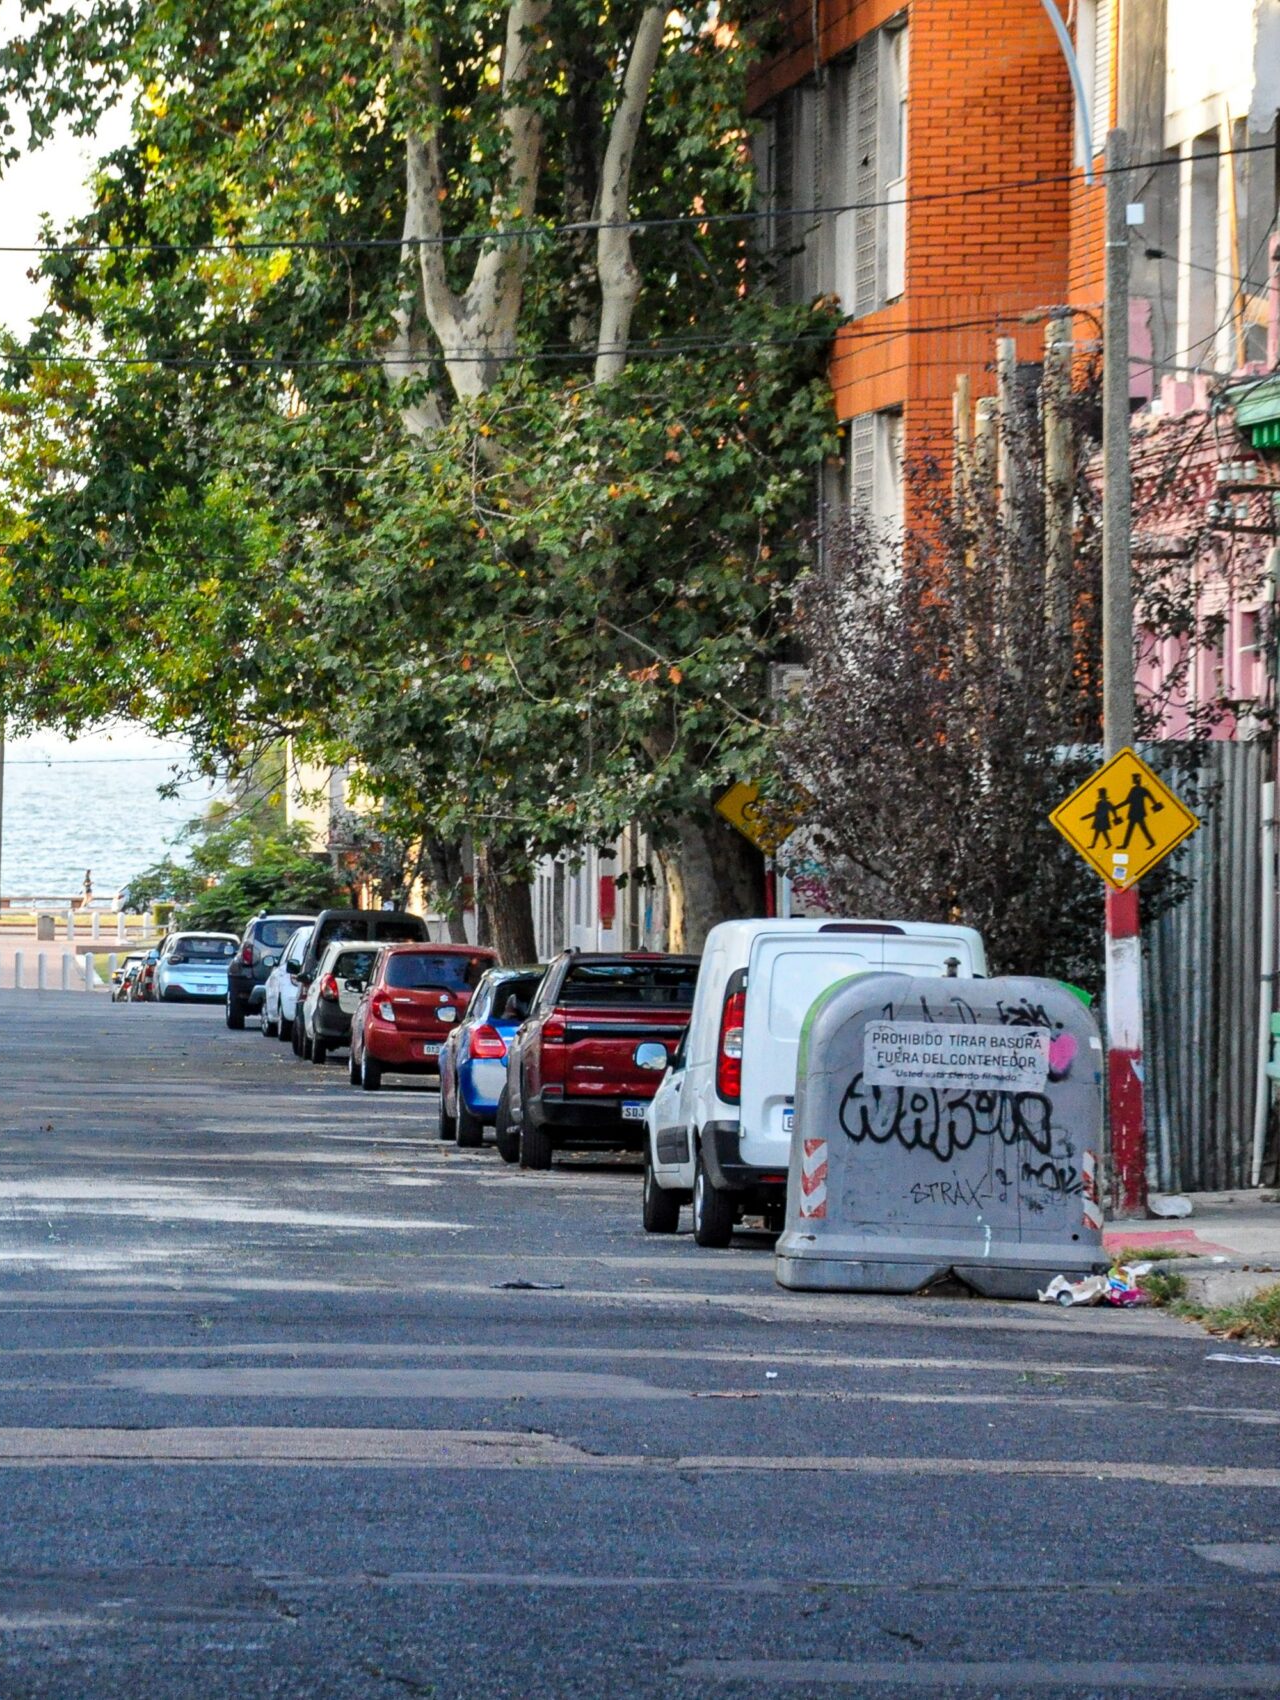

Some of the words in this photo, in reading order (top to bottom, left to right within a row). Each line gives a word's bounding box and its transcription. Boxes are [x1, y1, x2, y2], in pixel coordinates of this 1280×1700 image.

[872, 1032, 943, 1046] PROHIBIDO
[950, 1034, 987, 1047] TIRAR
[990, 1036, 1042, 1049] BASURA
[877, 1052, 920, 1065] FUERA
[923, 1053, 946, 1065] DEL
[950, 1053, 1036, 1068] CONTENEDOR
